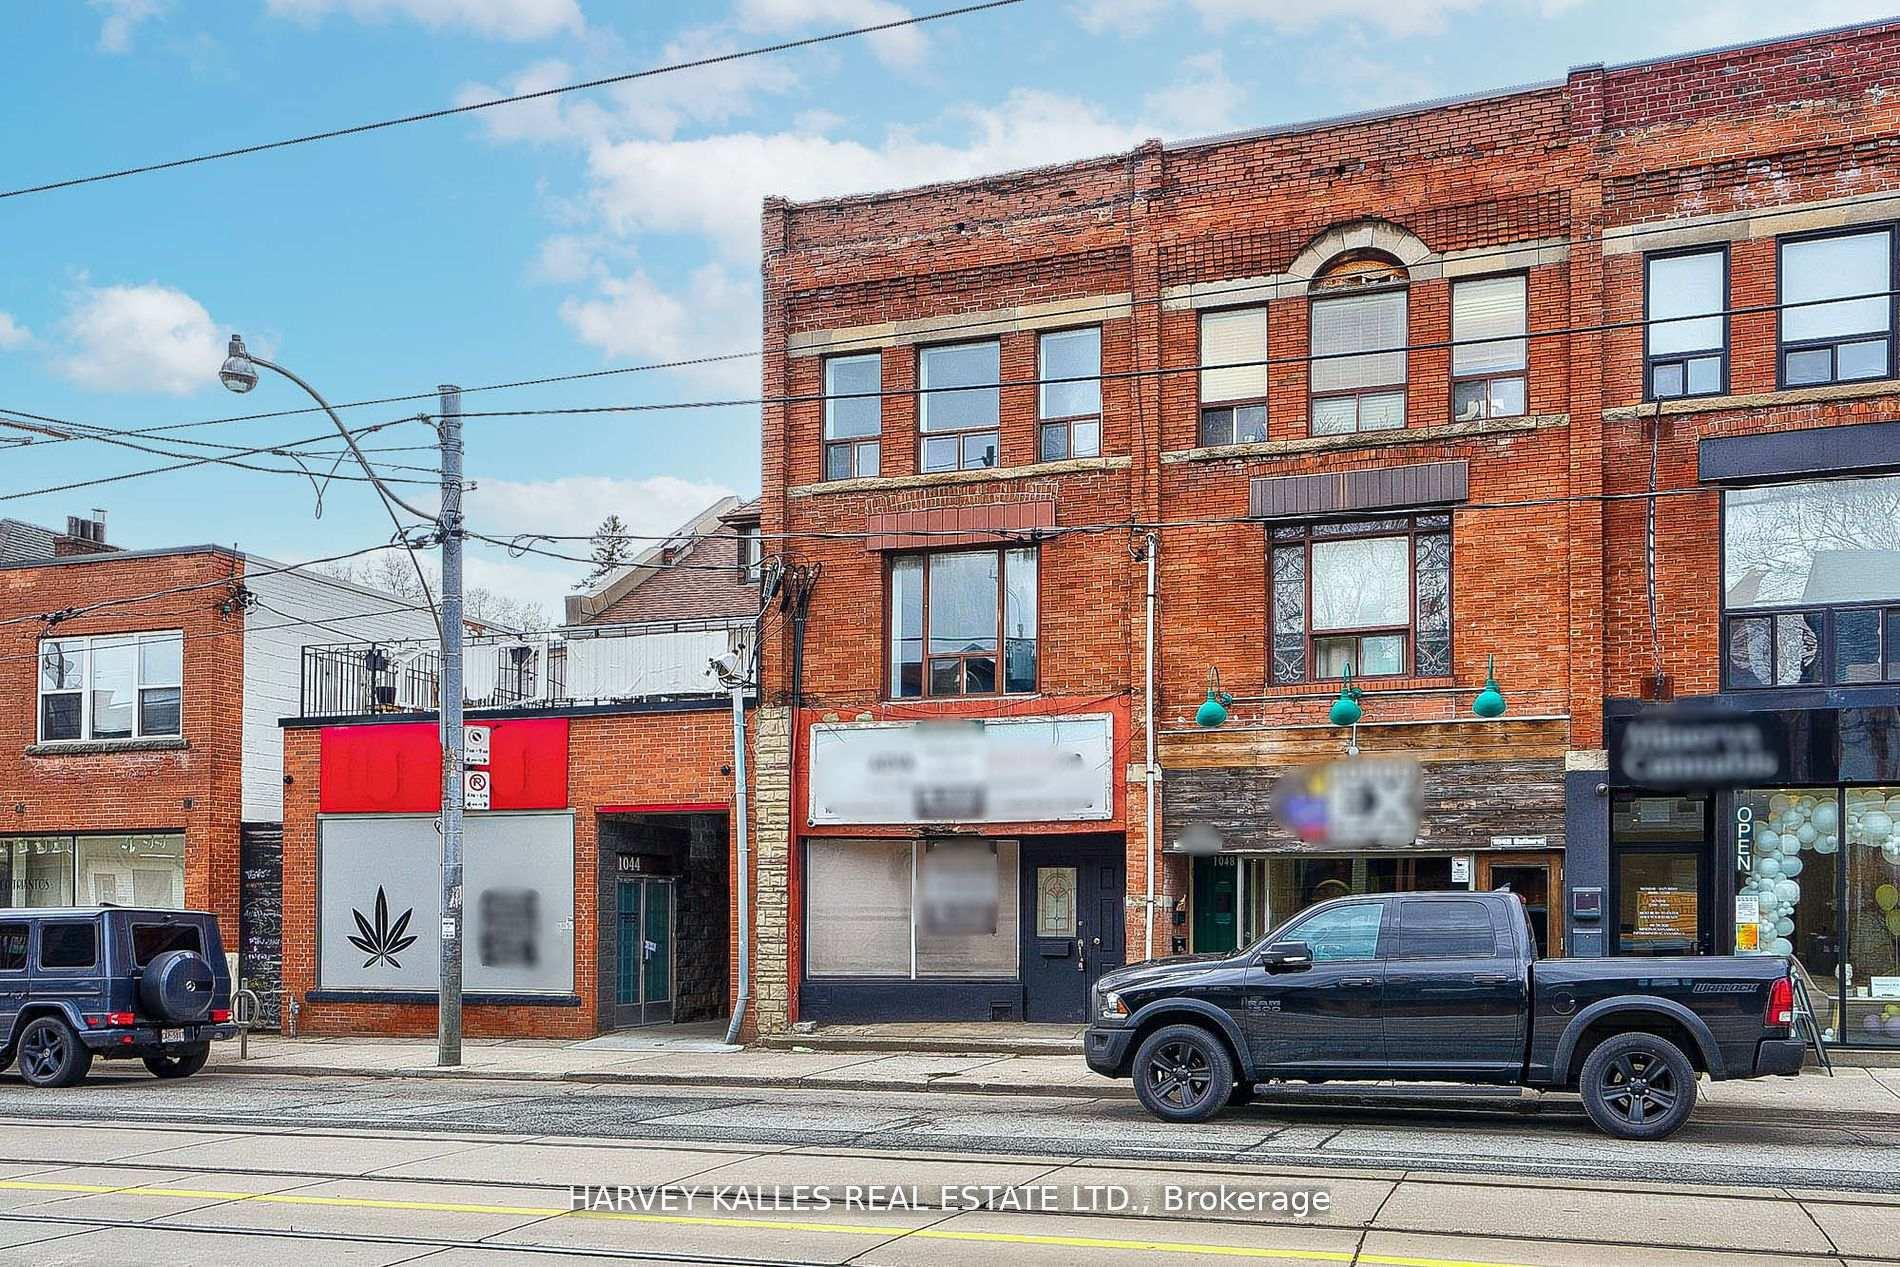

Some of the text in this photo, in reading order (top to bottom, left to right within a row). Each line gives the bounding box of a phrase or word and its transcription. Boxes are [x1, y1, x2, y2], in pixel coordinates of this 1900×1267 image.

[1737, 806, 1752, 871] OPEN
[618, 856, 641, 871] 1044
[1214, 856, 1236, 867] 1048
[1692, 983, 1761, 994] WARLOCK
